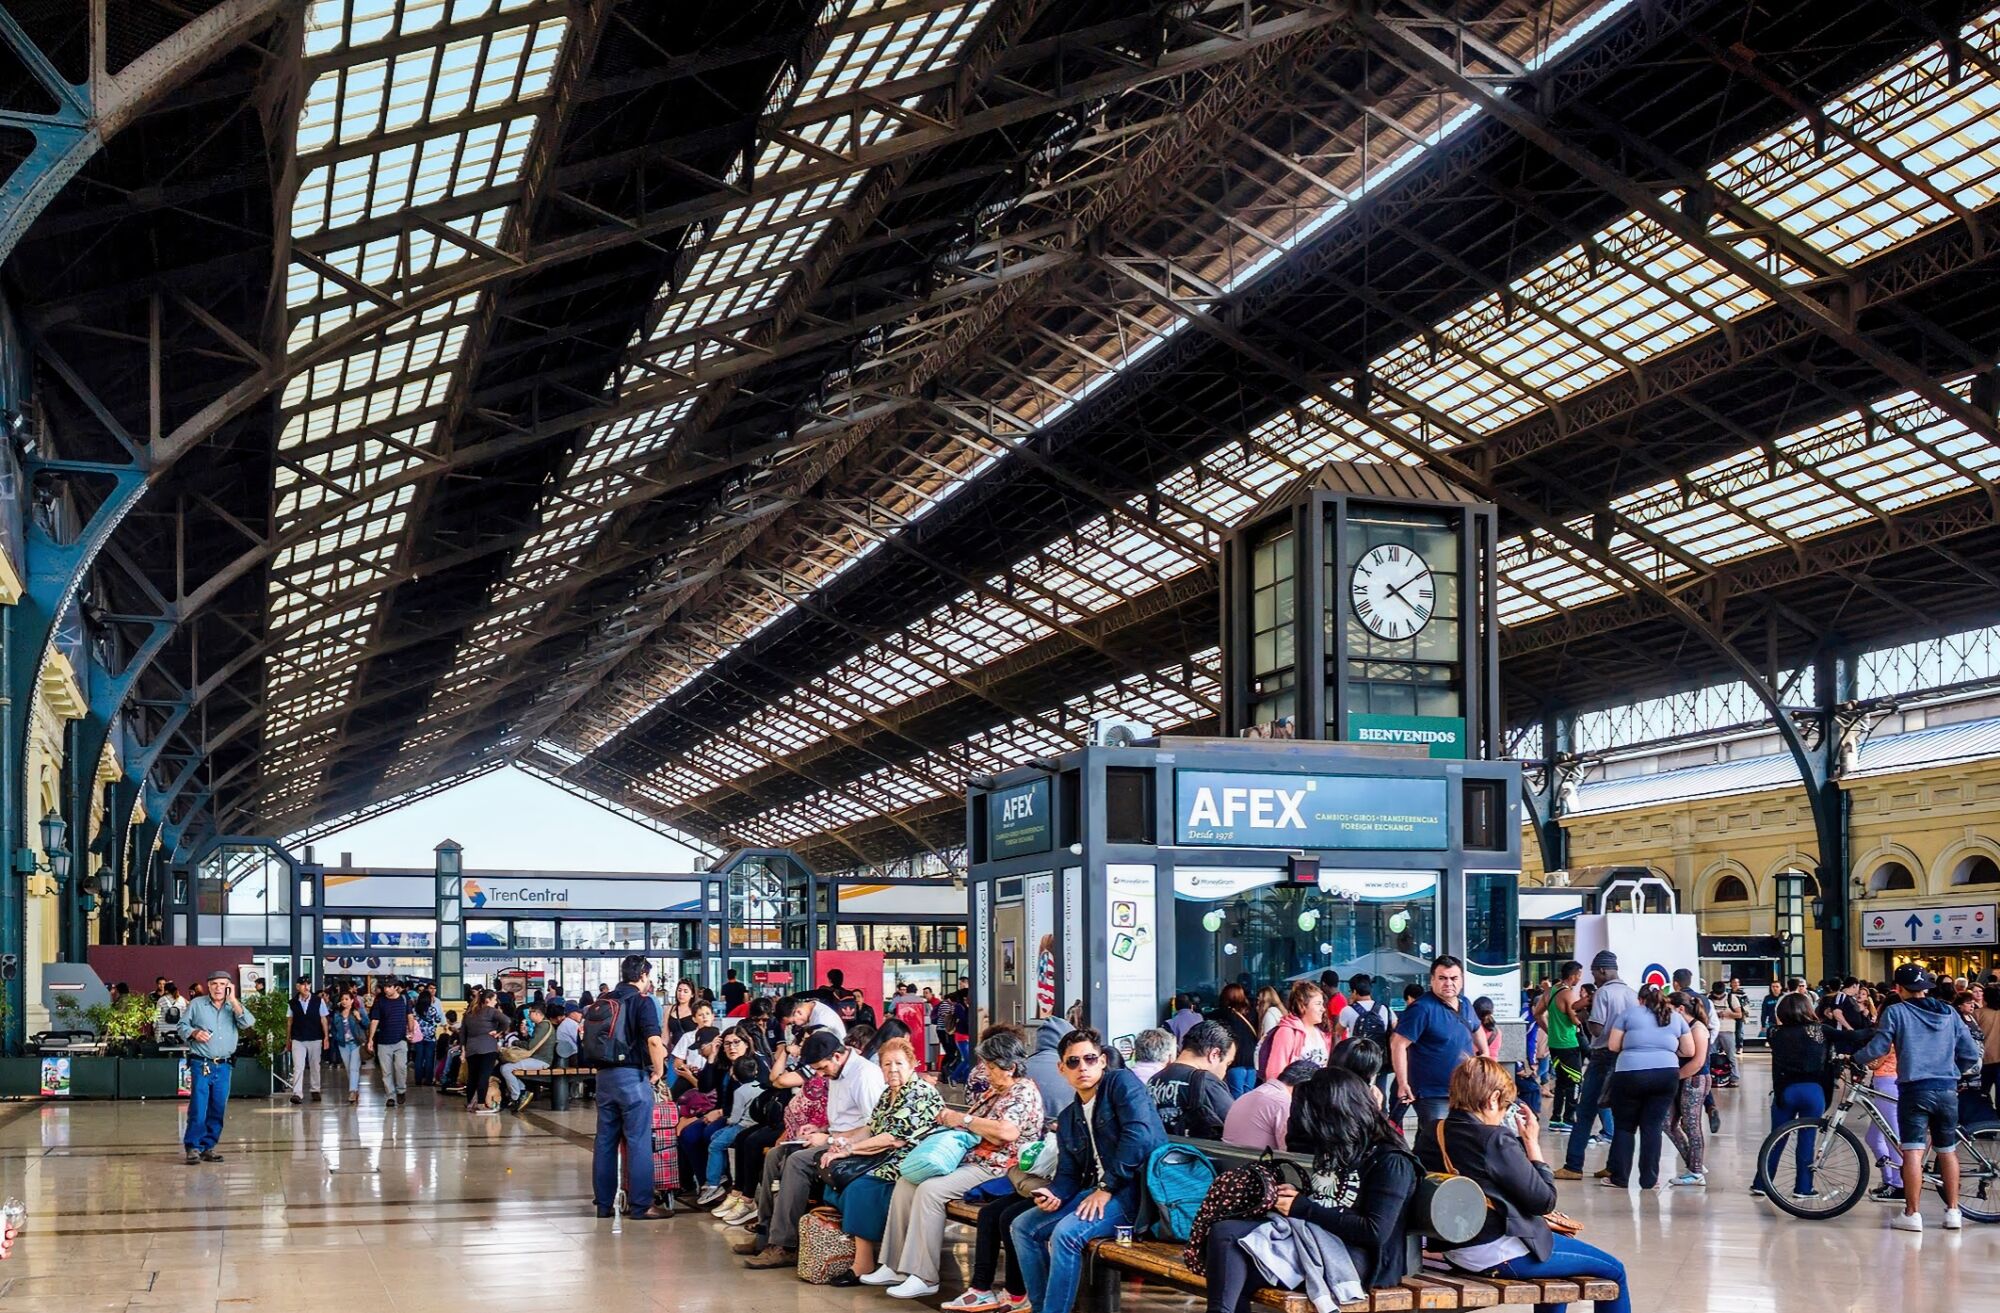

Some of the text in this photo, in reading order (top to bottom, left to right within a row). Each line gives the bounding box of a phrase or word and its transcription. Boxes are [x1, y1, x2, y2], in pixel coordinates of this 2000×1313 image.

[1359, 728, 1456, 743] BIENVENIDOS
[1003, 792, 1034, 822] AFEX
[1188, 787, 1307, 829] AFEX
[1374, 823, 1414, 832] EXCHANGE
[1188, 830, 1234, 841] Desde 1978
[1200, 879, 1235, 887] MoneyGram
[1365, 881, 1409, 889] www.afex.cl
[489, 887, 568, 902] TrenCentral
[1065, 924, 1071, 941] de
[1712, 942, 1747, 952] vtr.com
